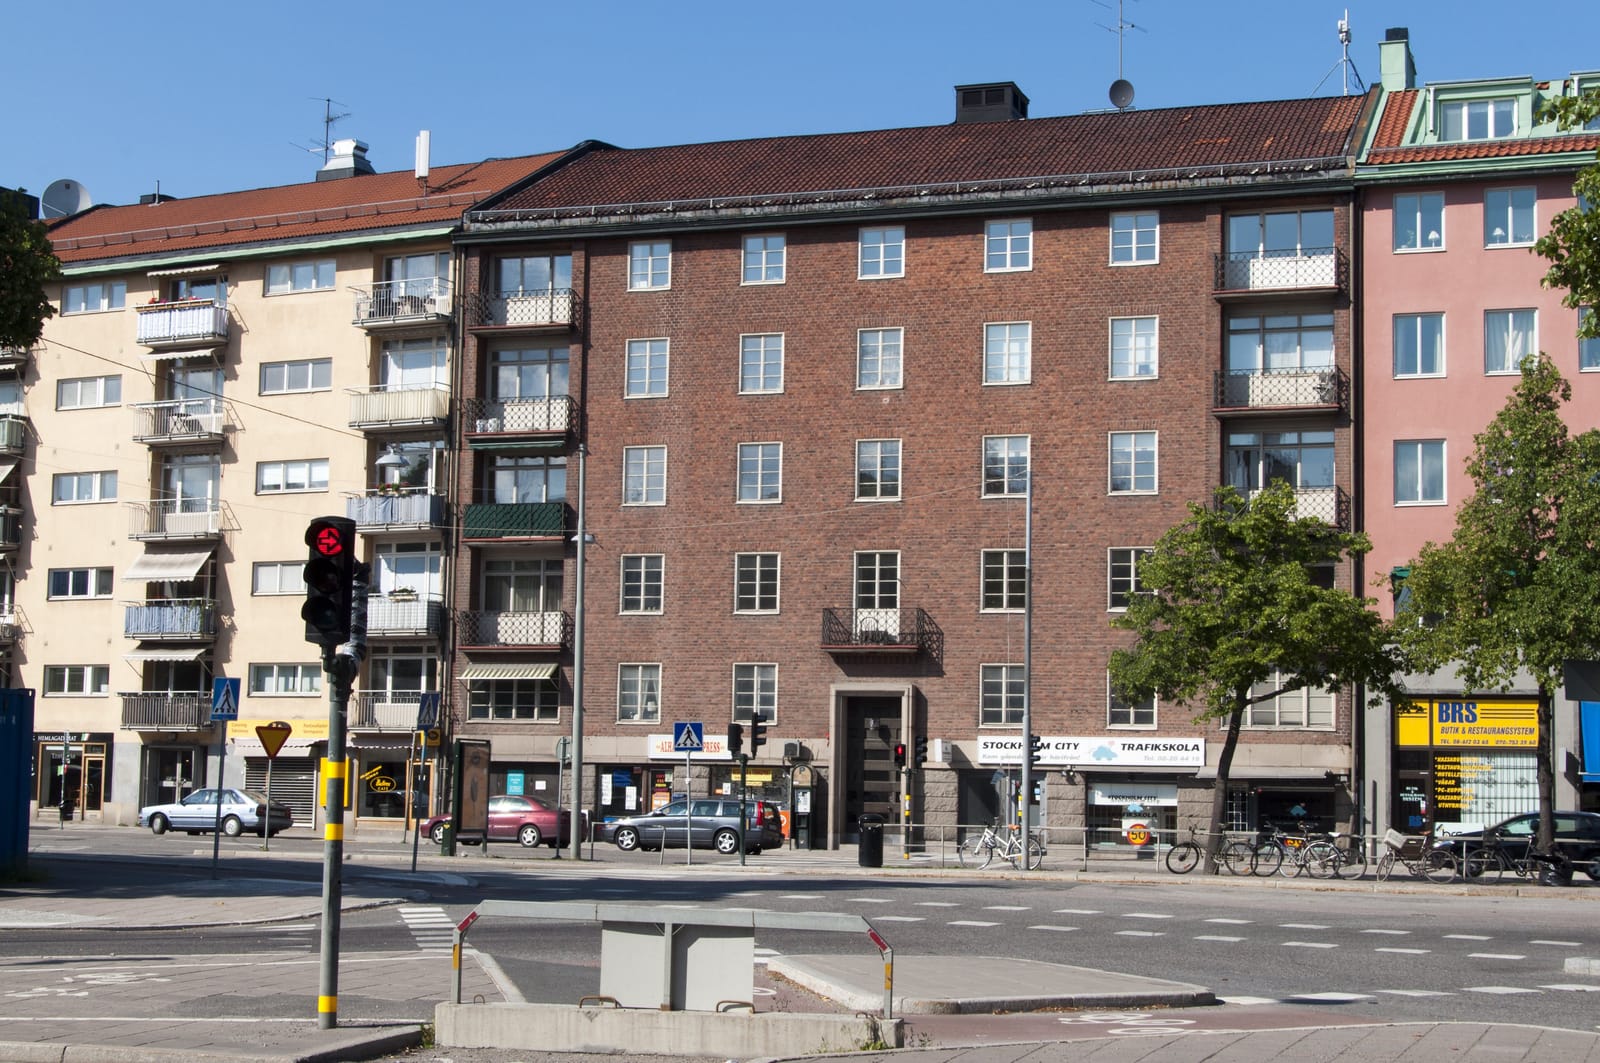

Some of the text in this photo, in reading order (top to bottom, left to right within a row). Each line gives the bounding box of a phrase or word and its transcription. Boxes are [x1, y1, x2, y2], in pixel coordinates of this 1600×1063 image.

[1438, 702, 1477, 723] BRS
[1440, 726, 1459, 734] BUTIK
[1468, 727, 1535, 735] RESTAURANGSYSTEM
[1055, 742, 1080, 750] CITY
[1120, 743, 1200, 752] TRAFIKSKOLA
